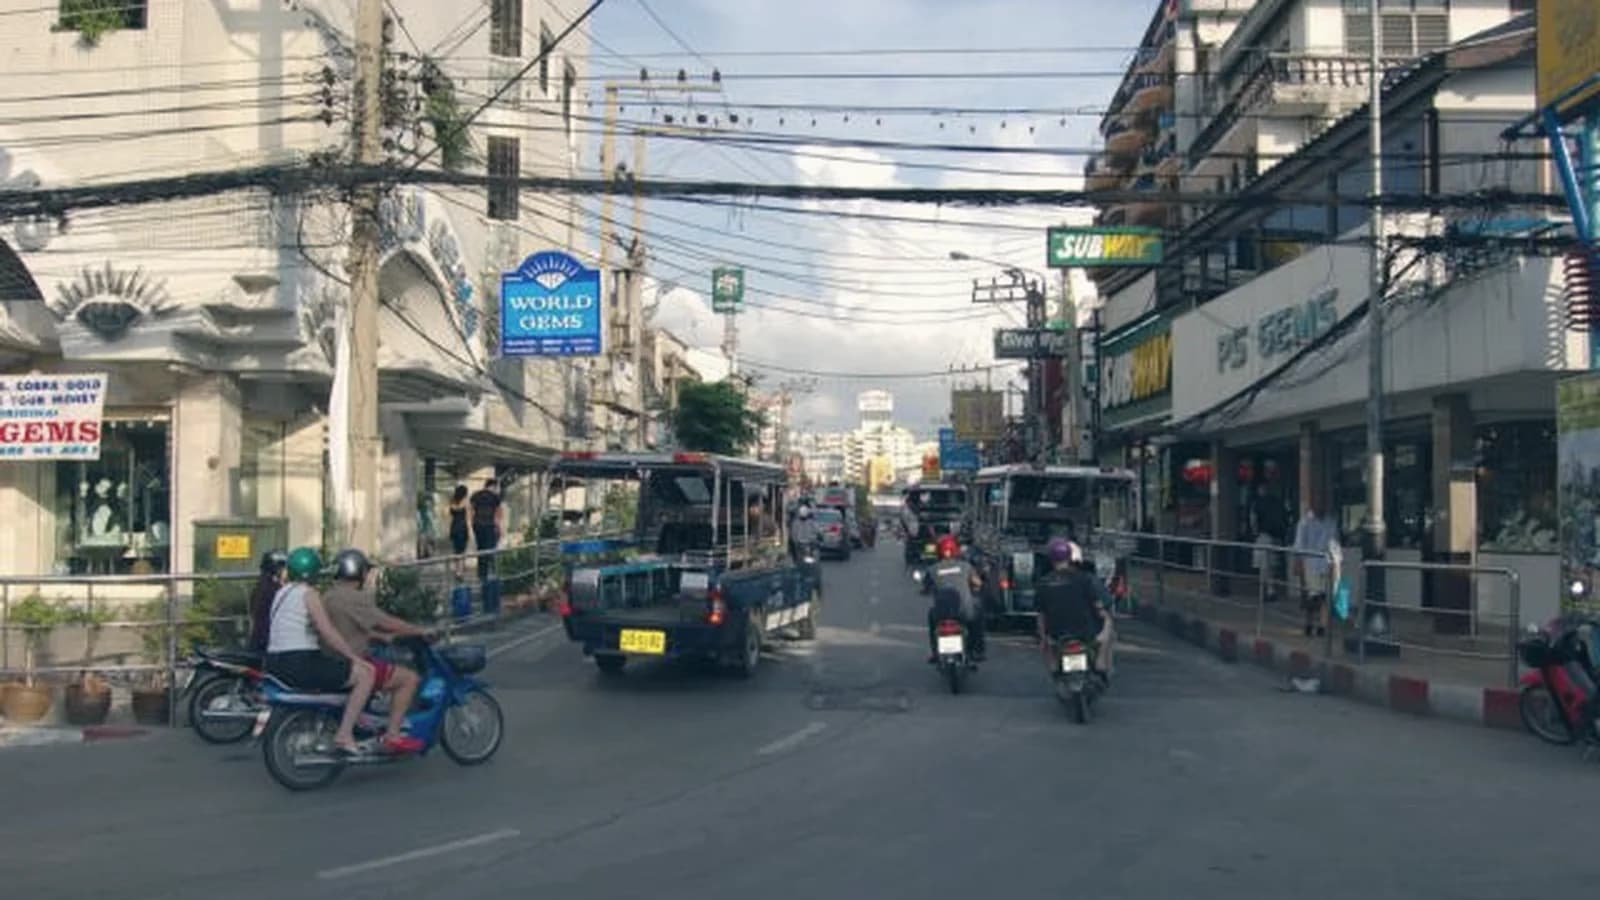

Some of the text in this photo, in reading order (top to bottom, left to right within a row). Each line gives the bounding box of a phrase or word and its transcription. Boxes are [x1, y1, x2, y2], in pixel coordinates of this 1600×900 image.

[1055, 233, 1159, 259] SUBWAY
[509, 294, 592, 310] WORLD
[520, 312, 582, 330] GEMS
[1216, 288, 1339, 374] PS GEMS
[1099, 333, 1173, 408] SUBWAY
[52, 394, 96, 404] MONEY
[0, 421, 99, 443] GEMS
